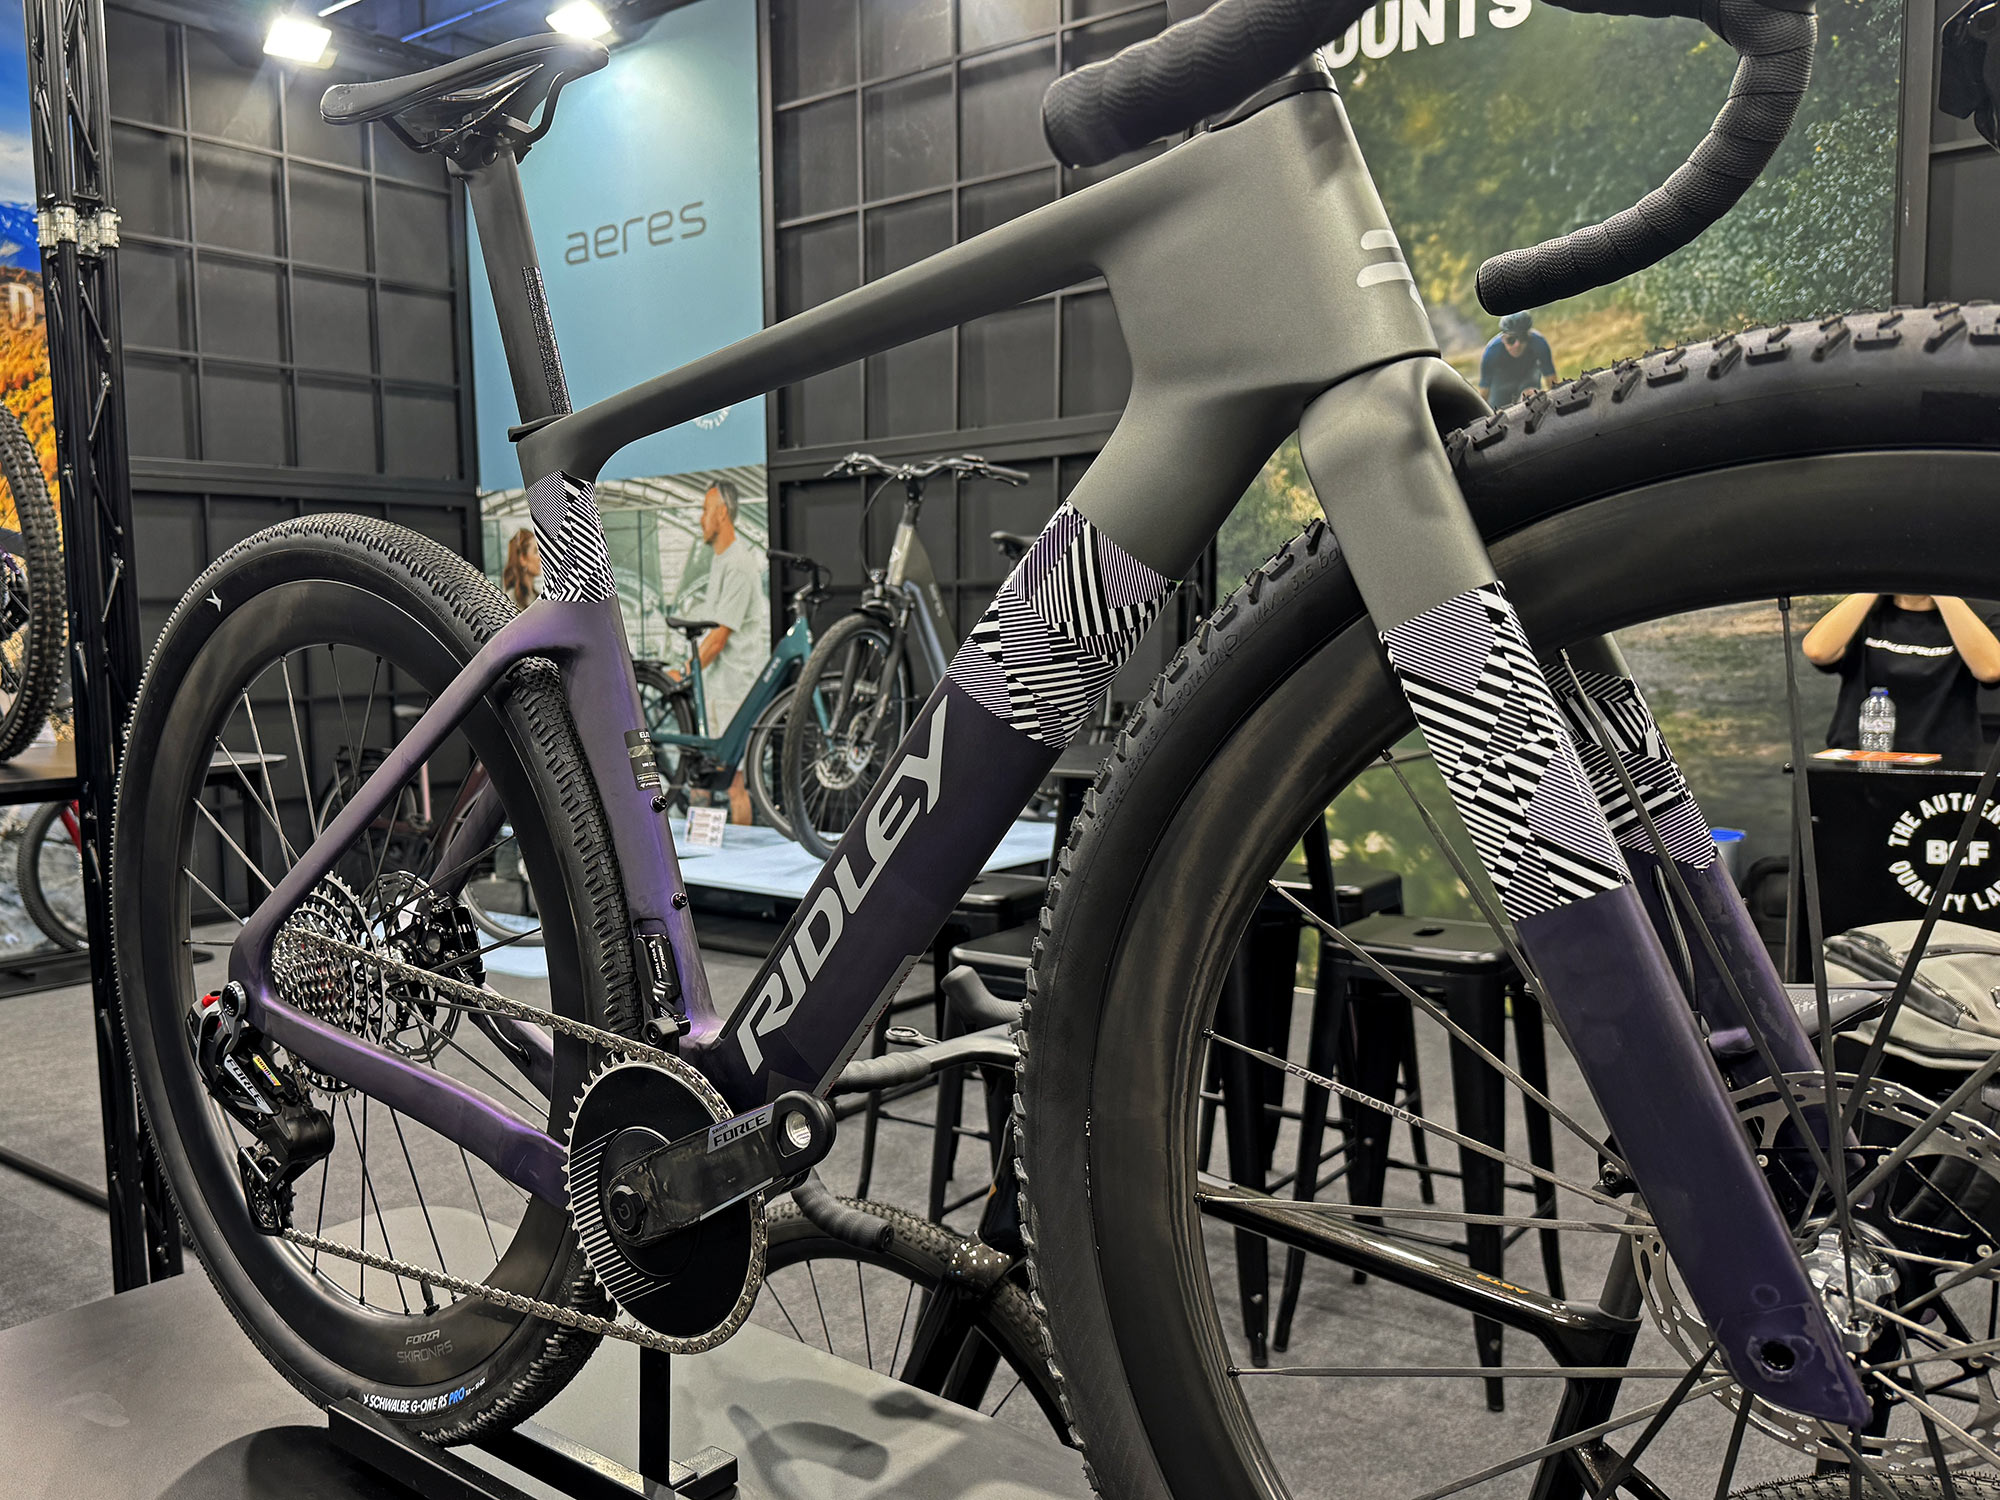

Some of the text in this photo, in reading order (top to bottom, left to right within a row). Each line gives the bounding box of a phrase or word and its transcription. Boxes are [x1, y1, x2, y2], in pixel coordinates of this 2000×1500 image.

[564, 201, 707, 266] aeres
[1174, 645, 1230, 701] ROTATION
[1888, 792, 2000, 847] THE AUTHEN
[736, 694, 948, 1075] RIDLEY
[1888, 860, 1967, 914] QUALTY
[226, 1058, 263, 1105] FORCE
[1284, 1062, 1347, 1095] FORZA
[713, 1112, 768, 1147] FORCE
[405, 1329, 441, 1346] FORZA
[368, 1394, 410, 1413] SCHWALBE
[410, 1397, 438, 1413] G-ONE
[437, 1393, 449, 1409] RS
[448, 1386, 466, 1406] PRO
